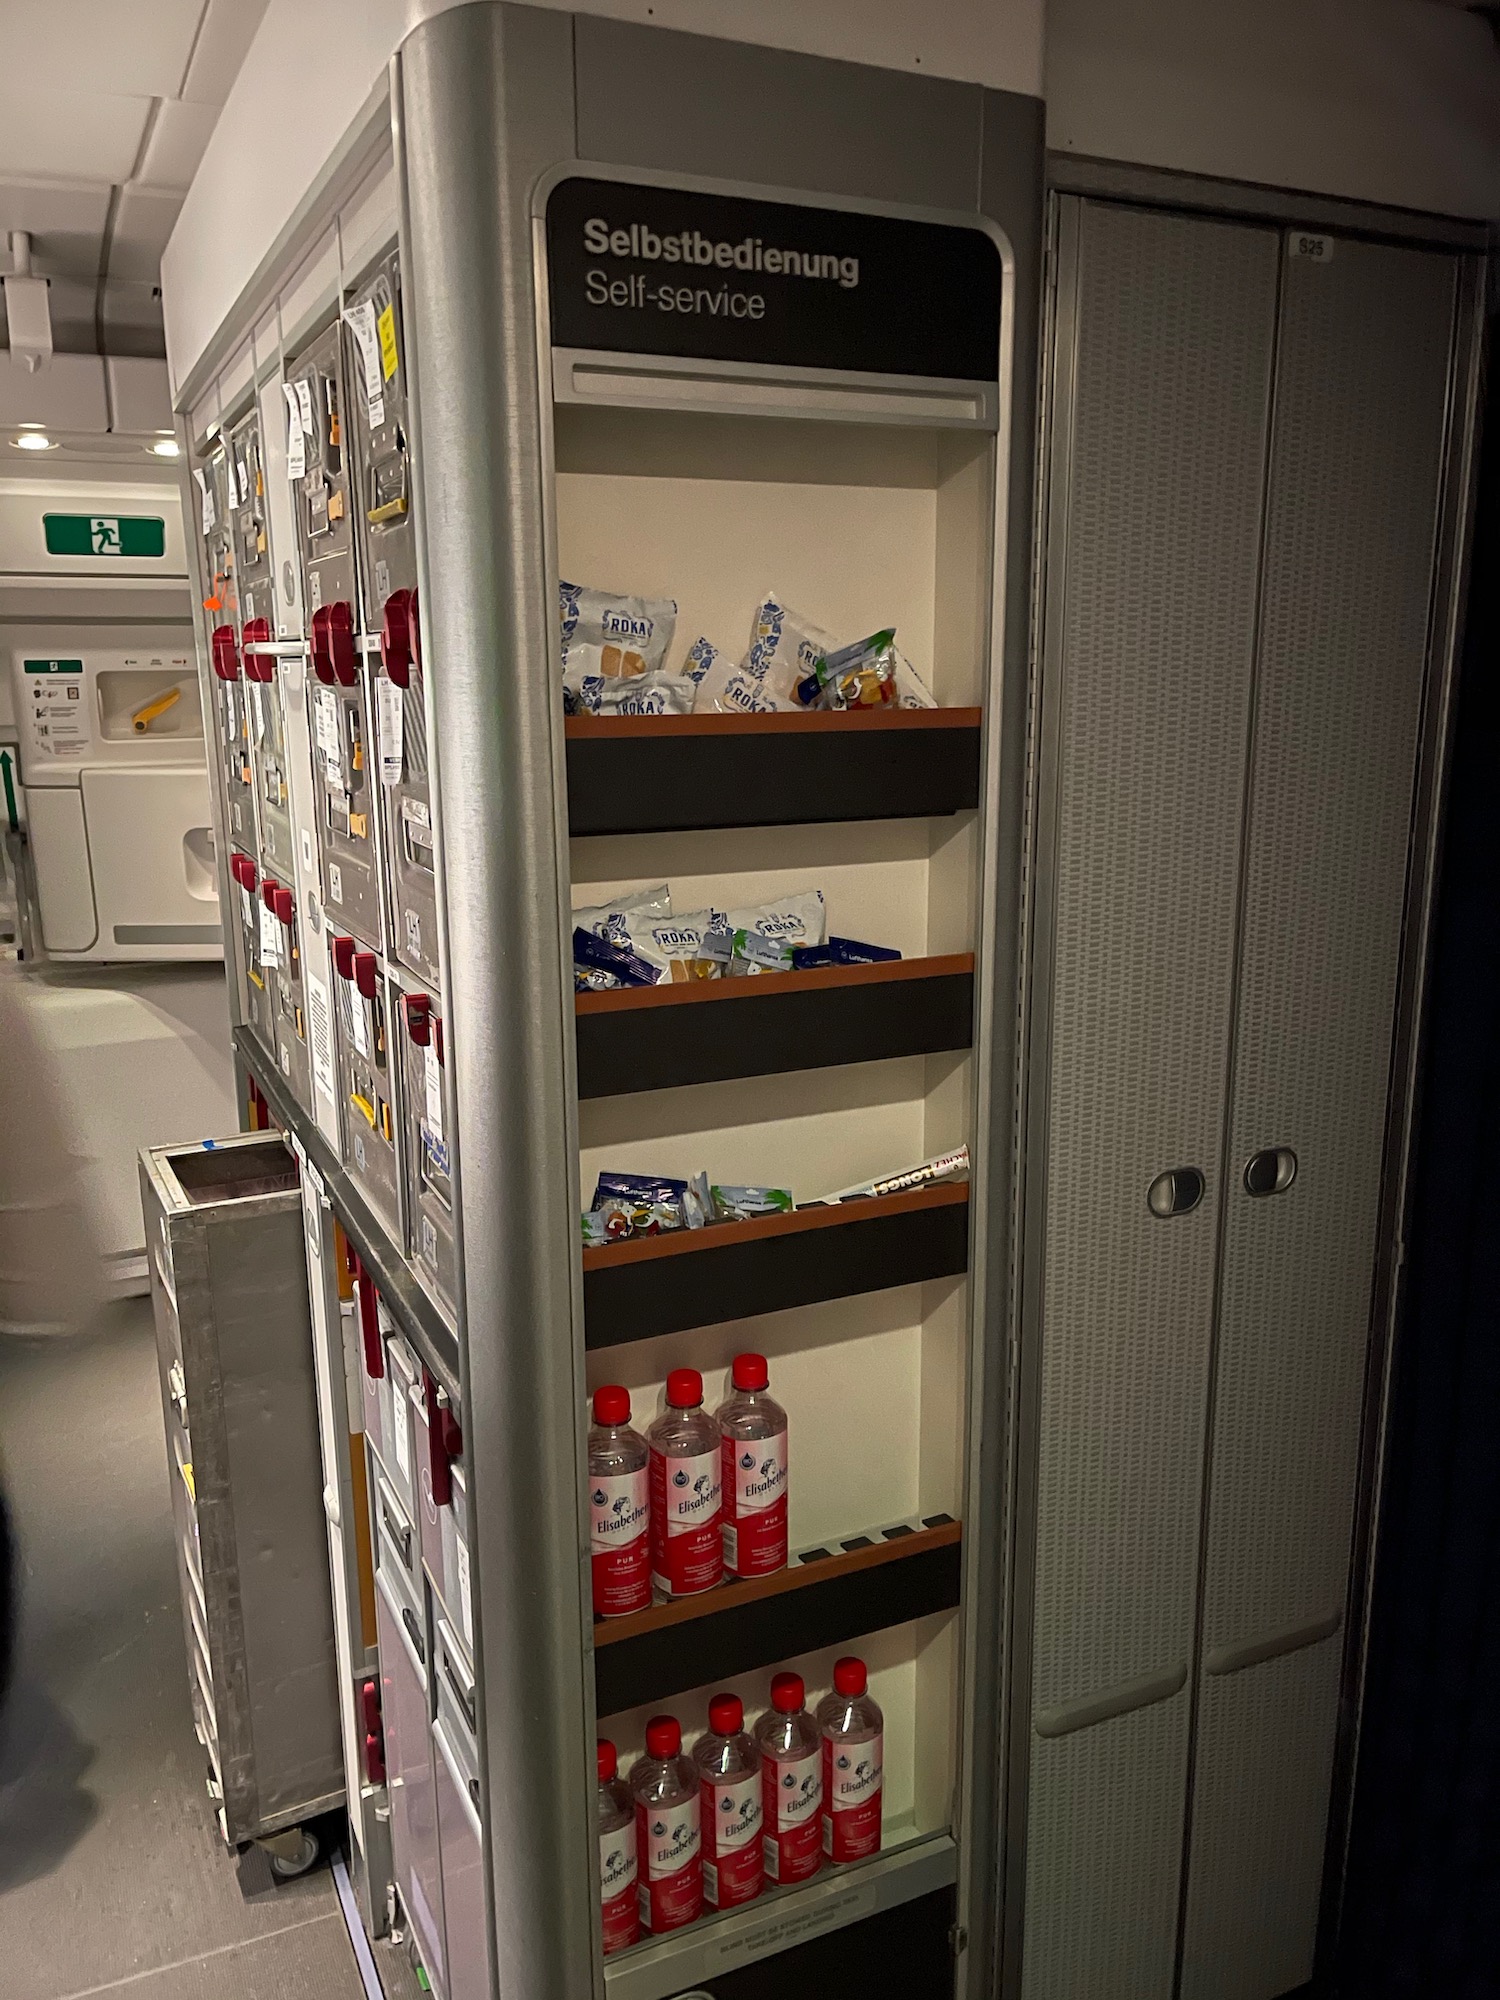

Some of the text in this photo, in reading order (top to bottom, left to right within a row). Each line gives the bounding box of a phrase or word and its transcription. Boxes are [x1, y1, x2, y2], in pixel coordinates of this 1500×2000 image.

[583, 218, 859, 288] Selbstbedienung
[585, 270, 766, 320] Self-service
[610, 618, 646, 636] ROKA
[622, 701, 655, 715] ROKA
[732, 687, 767, 713] ROKA
[765, 921, 797, 934] ROKA
[661, 932, 695, 944] ROKA
[878, 1167, 932, 1195] LONGS
[696, 1533, 712, 1543] PUR
[616, 1556, 634, 1565] PUR
